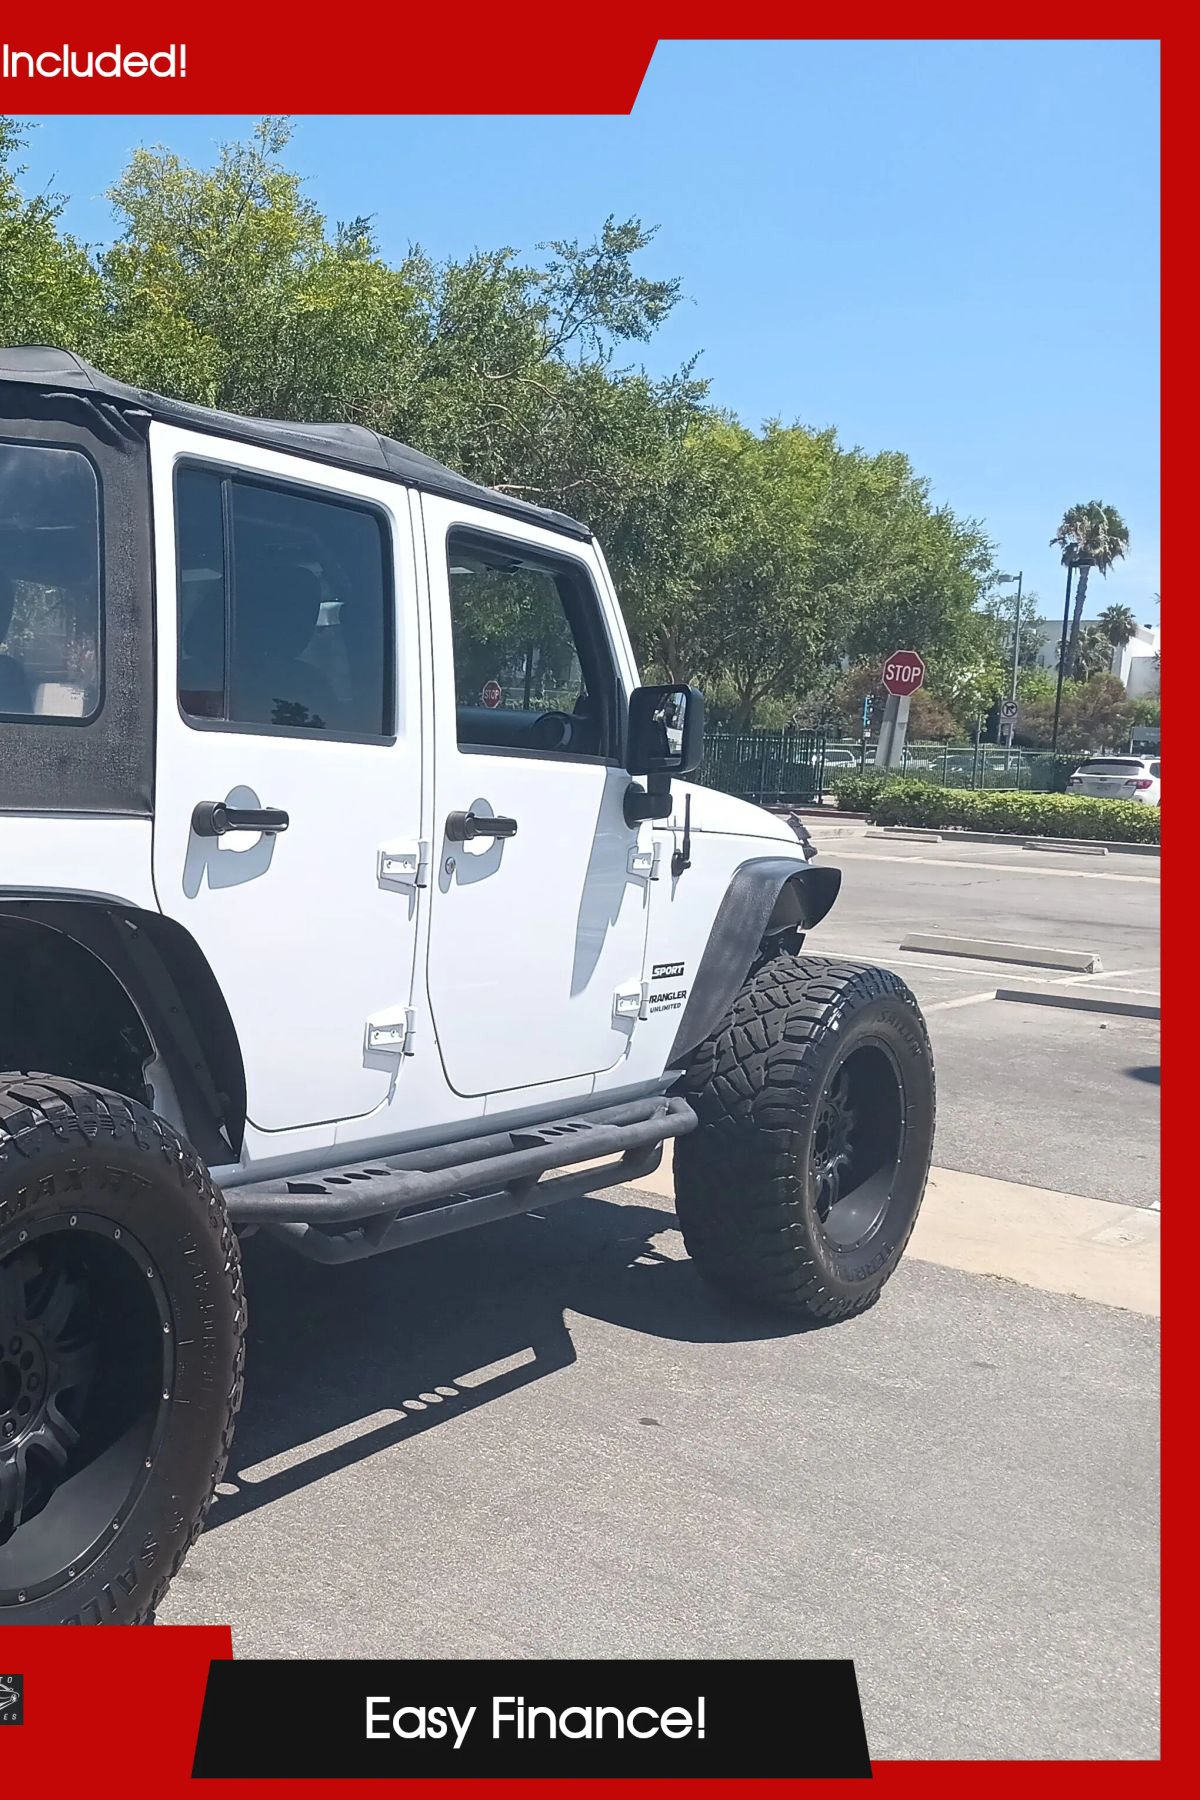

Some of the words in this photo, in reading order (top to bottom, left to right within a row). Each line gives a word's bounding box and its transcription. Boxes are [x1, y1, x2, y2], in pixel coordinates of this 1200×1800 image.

[886, 664, 921, 683] STOP
[484, 689, 500, 700] STOP
[653, 964, 684, 978] SPORT
[648, 990, 687, 1004] RANGLER
[649, 1002, 682, 1014] UNLIMITED
